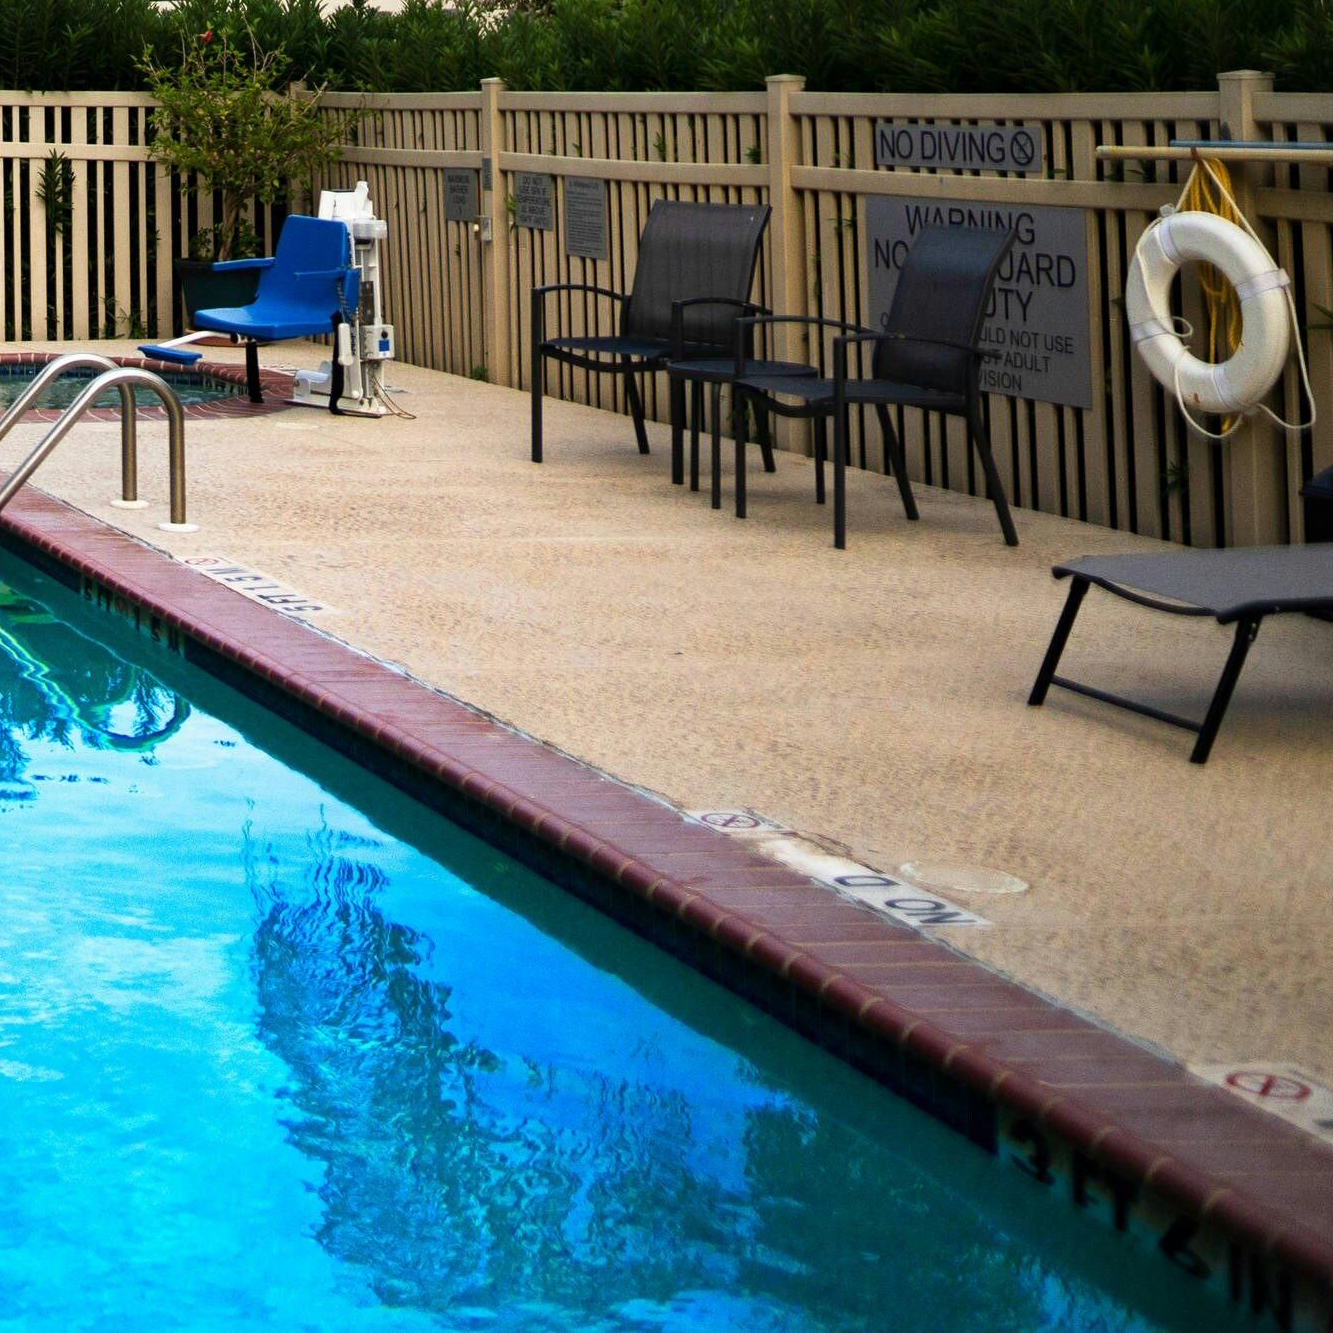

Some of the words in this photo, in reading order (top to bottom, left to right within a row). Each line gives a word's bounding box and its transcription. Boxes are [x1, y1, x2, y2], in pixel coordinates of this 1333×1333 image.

[880, 129, 914, 160] NO
[921, 130, 1006, 164] DIVING
[985, 288, 1033, 322] UTY
[1010, 330, 1039, 349] NOT
[1044, 334, 1074, 354] USE
[1005, 351, 1051, 373] ADULT
[884, 898, 978, 925] NO
